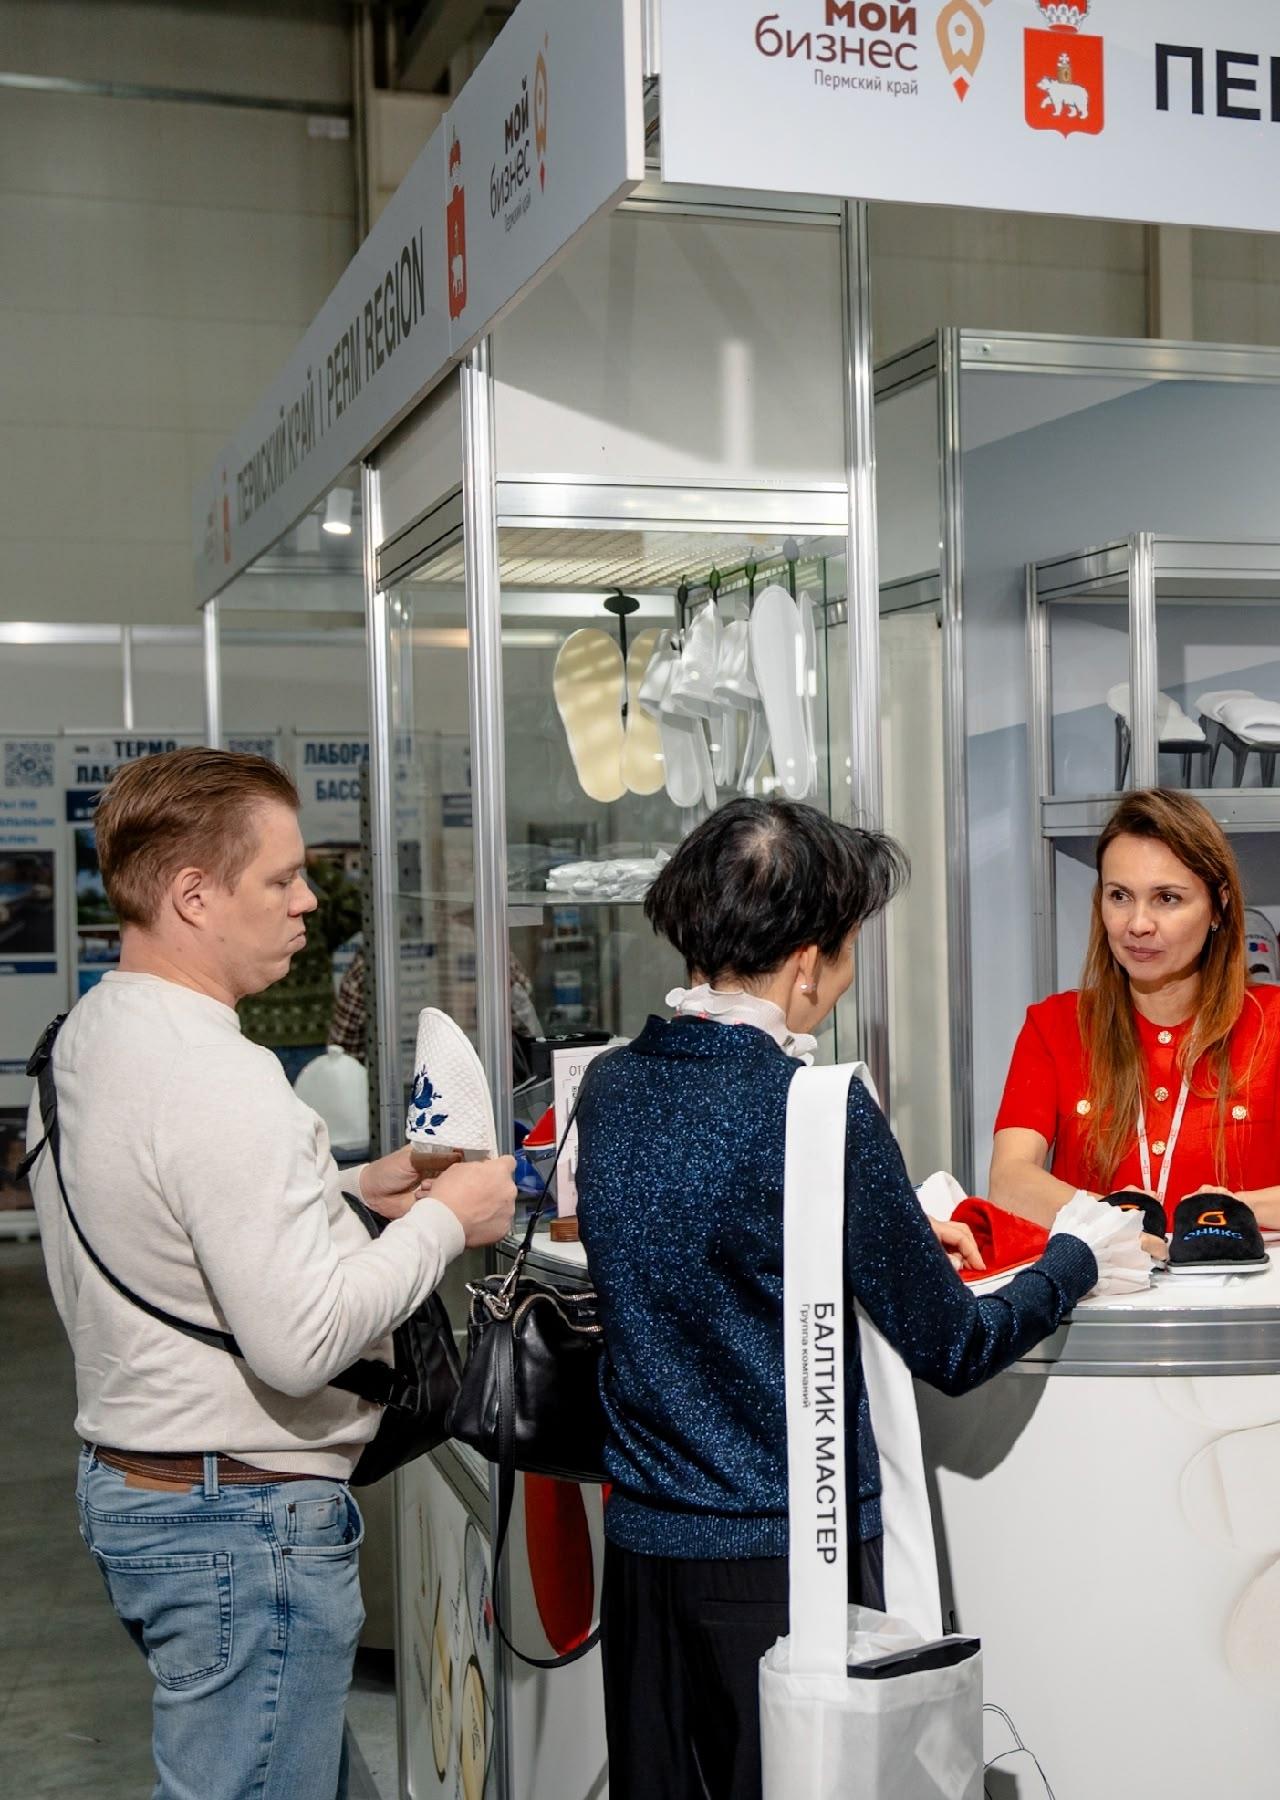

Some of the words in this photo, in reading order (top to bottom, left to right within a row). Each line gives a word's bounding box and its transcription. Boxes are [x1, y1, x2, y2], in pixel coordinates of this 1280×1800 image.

[755, 13, 918, 71] бизнес
[814, 68, 883, 92] Пермский
[887, 79, 919, 98] край
[490, 140, 531, 219] бизнес
[327, 316, 361, 429] PERM
[364, 226, 425, 384] REGION
[799, 1303, 811, 1346] Группа
[801, 1348, 811, 1409] компаний
[814, 1302, 835, 1426] БАЛТИК
[815, 1436, 837, 1564] МАСТЕР
